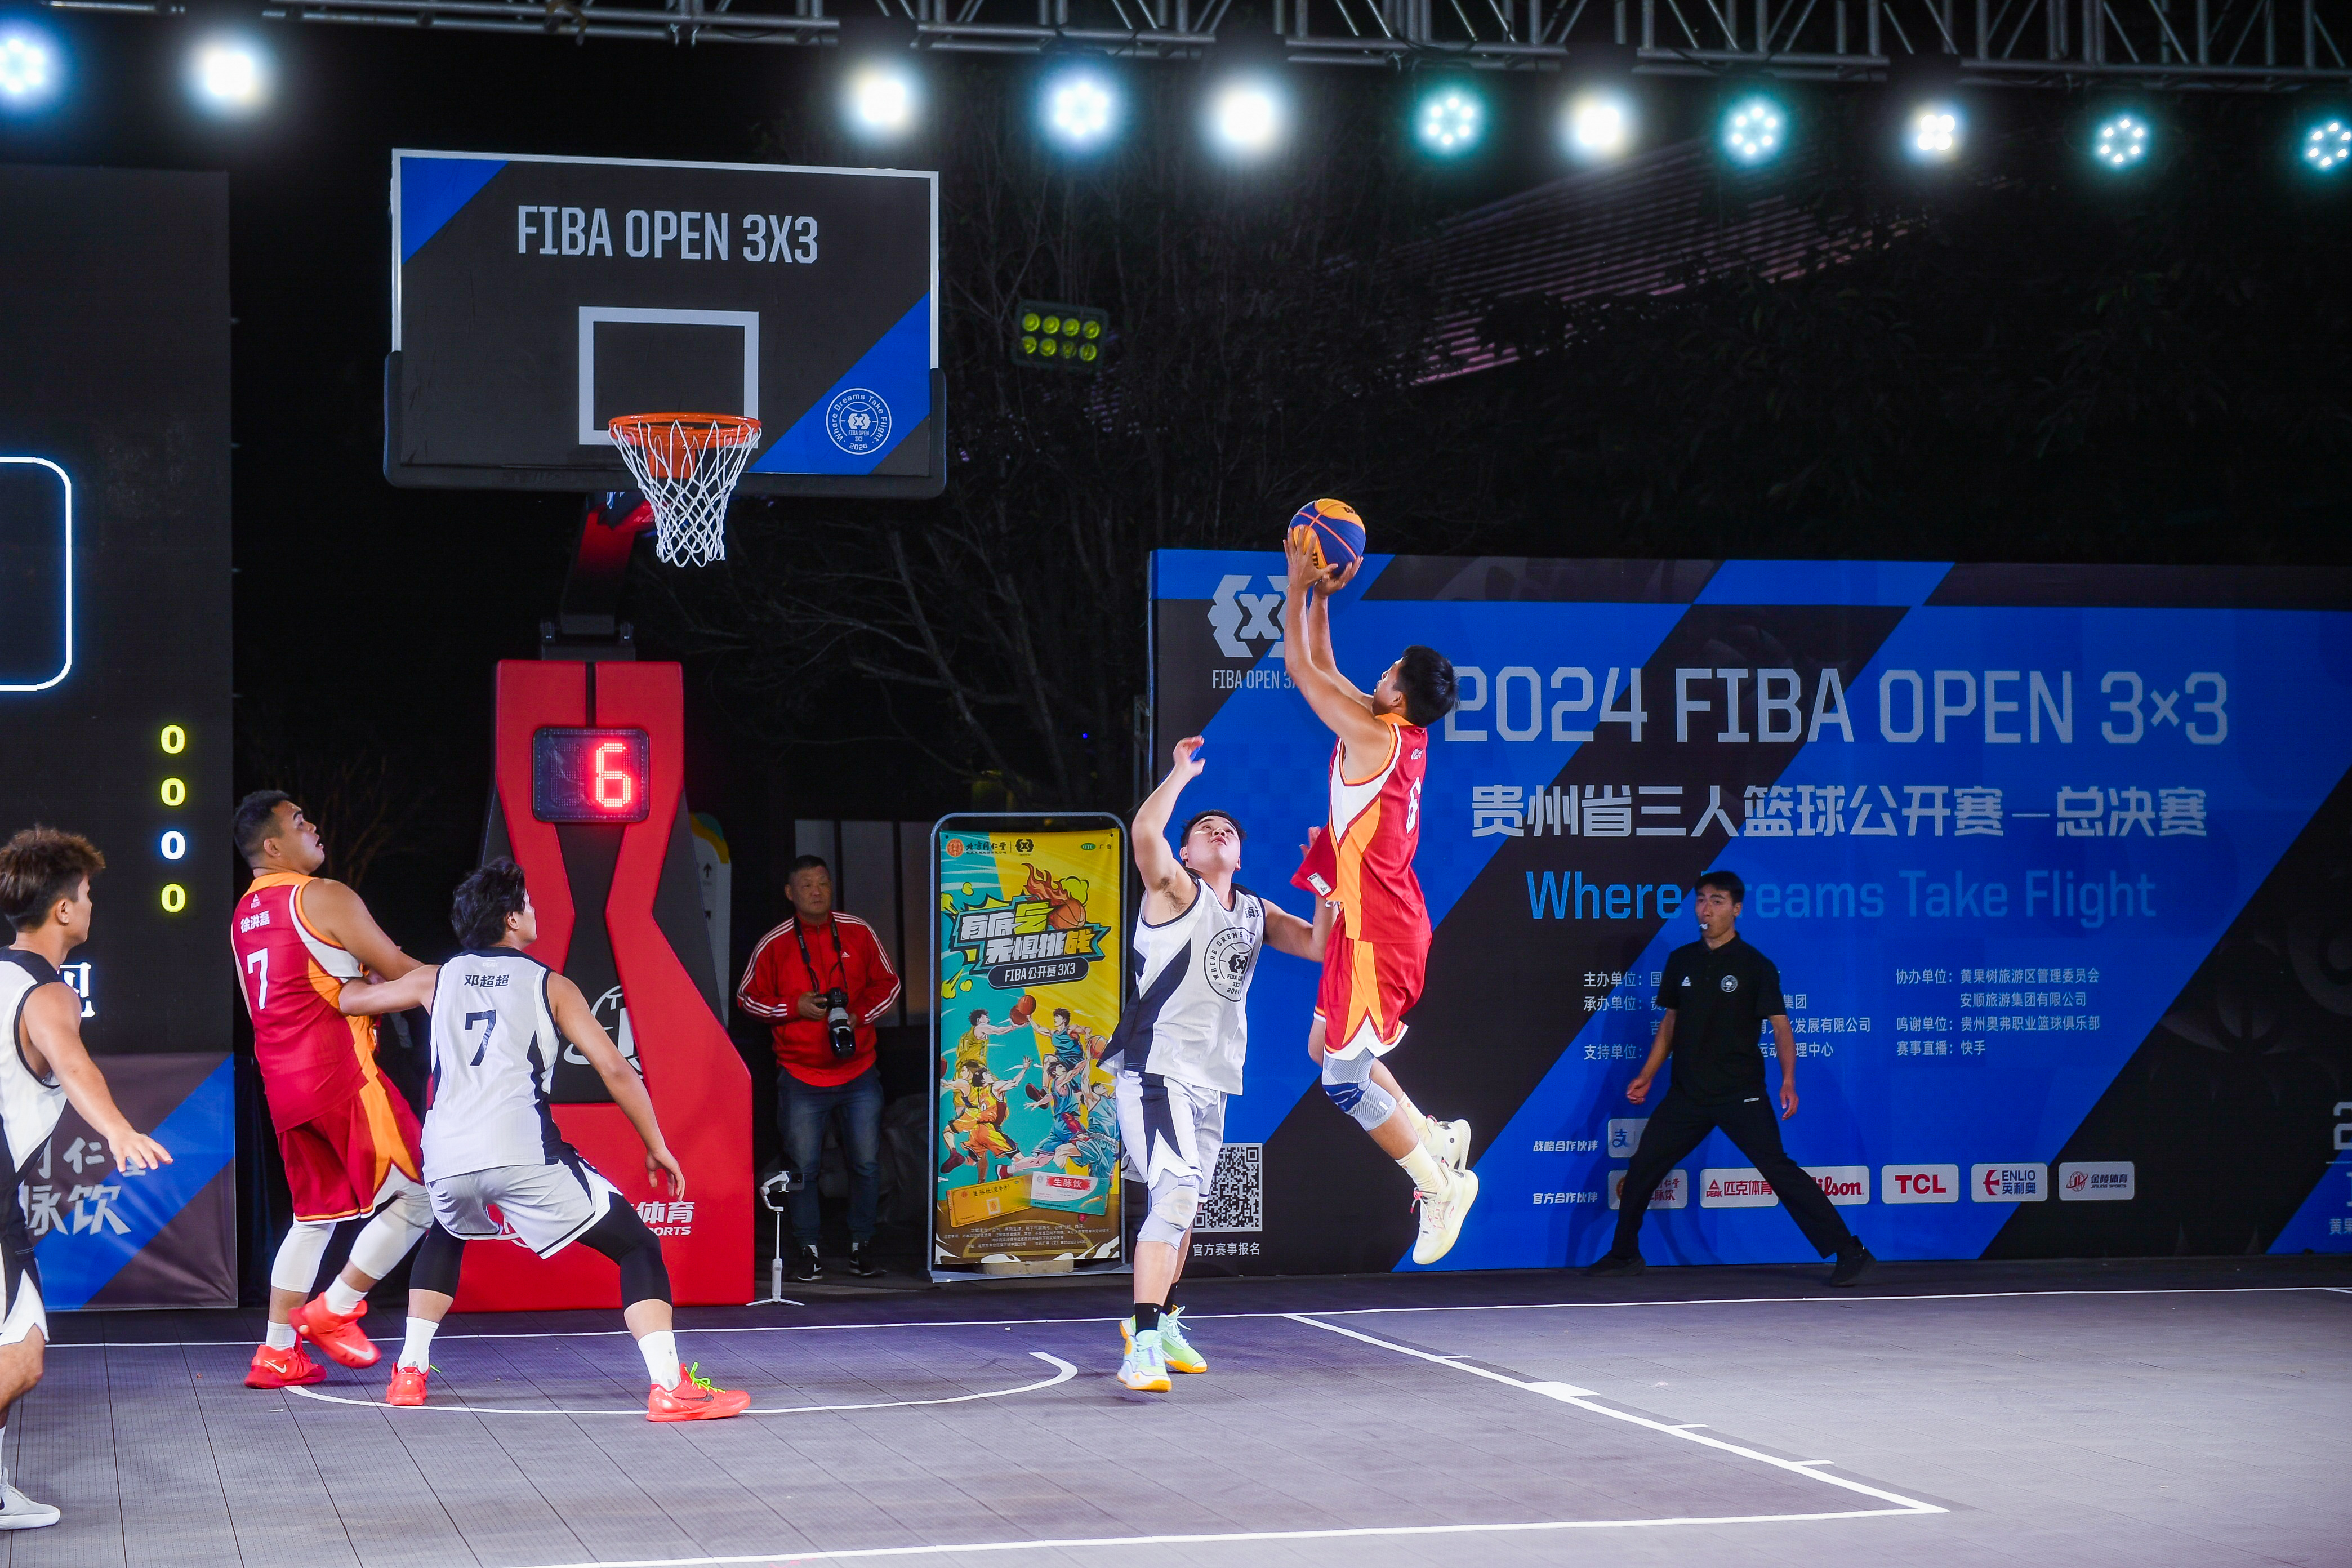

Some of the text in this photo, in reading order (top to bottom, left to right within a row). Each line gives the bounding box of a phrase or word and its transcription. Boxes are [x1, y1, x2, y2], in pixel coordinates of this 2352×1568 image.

[519, 206, 818, 264] FIBA OPEN 3X3
[832, 394, 888, 442] Where Dreams Take Flight
[1213, 670, 1243, 689] FIBA
[1246, 670, 1280, 689] OPEN
[1444, 666, 1647, 742] 2024
[1676, 668, 1855, 742] FIBA
[1879, 670, 2073, 743] OPEN
[161, 724, 185, 754] 0
[596, 743, 631, 807] 6
[161, 777, 185, 806] 0
[161, 831, 185, 860] 0
[161, 883, 185, 912] 0
[1526, 870, 2157, 929] Where reams Take Flight
[240, 910, 270, 934] 徐洪磊
[1210, 949, 1220, 981] WHERE
[1216, 932, 1243, 947] DREMS
[247, 947, 268, 1010] 7
[464, 974, 510, 988] 邓超超
[1004, 962, 1076, 982] FIBA 公开赛 3X3
[1960, 992, 2087, 1008] 安顺旅游集团有限公司
[465, 1009, 496, 1067] 7
[1533, 1140, 1598, 1152] 战略合作伙伴
[1053, 1178, 1083, 1188] 生脉饮
[1895, 1174, 1946, 1194] TCL
[2002, 1170, 2036, 1182] ENLIO
[2091, 1174, 2127, 1183] 金陵体育
[1533, 1192, 1598, 1205] 官方合作伙伴
[1723, 1180, 1773, 1196] 匹克体育
[2002, 1182, 2037, 1195] 英利奥
[1192, 1242, 1260, 1257] 官方赛事报名
